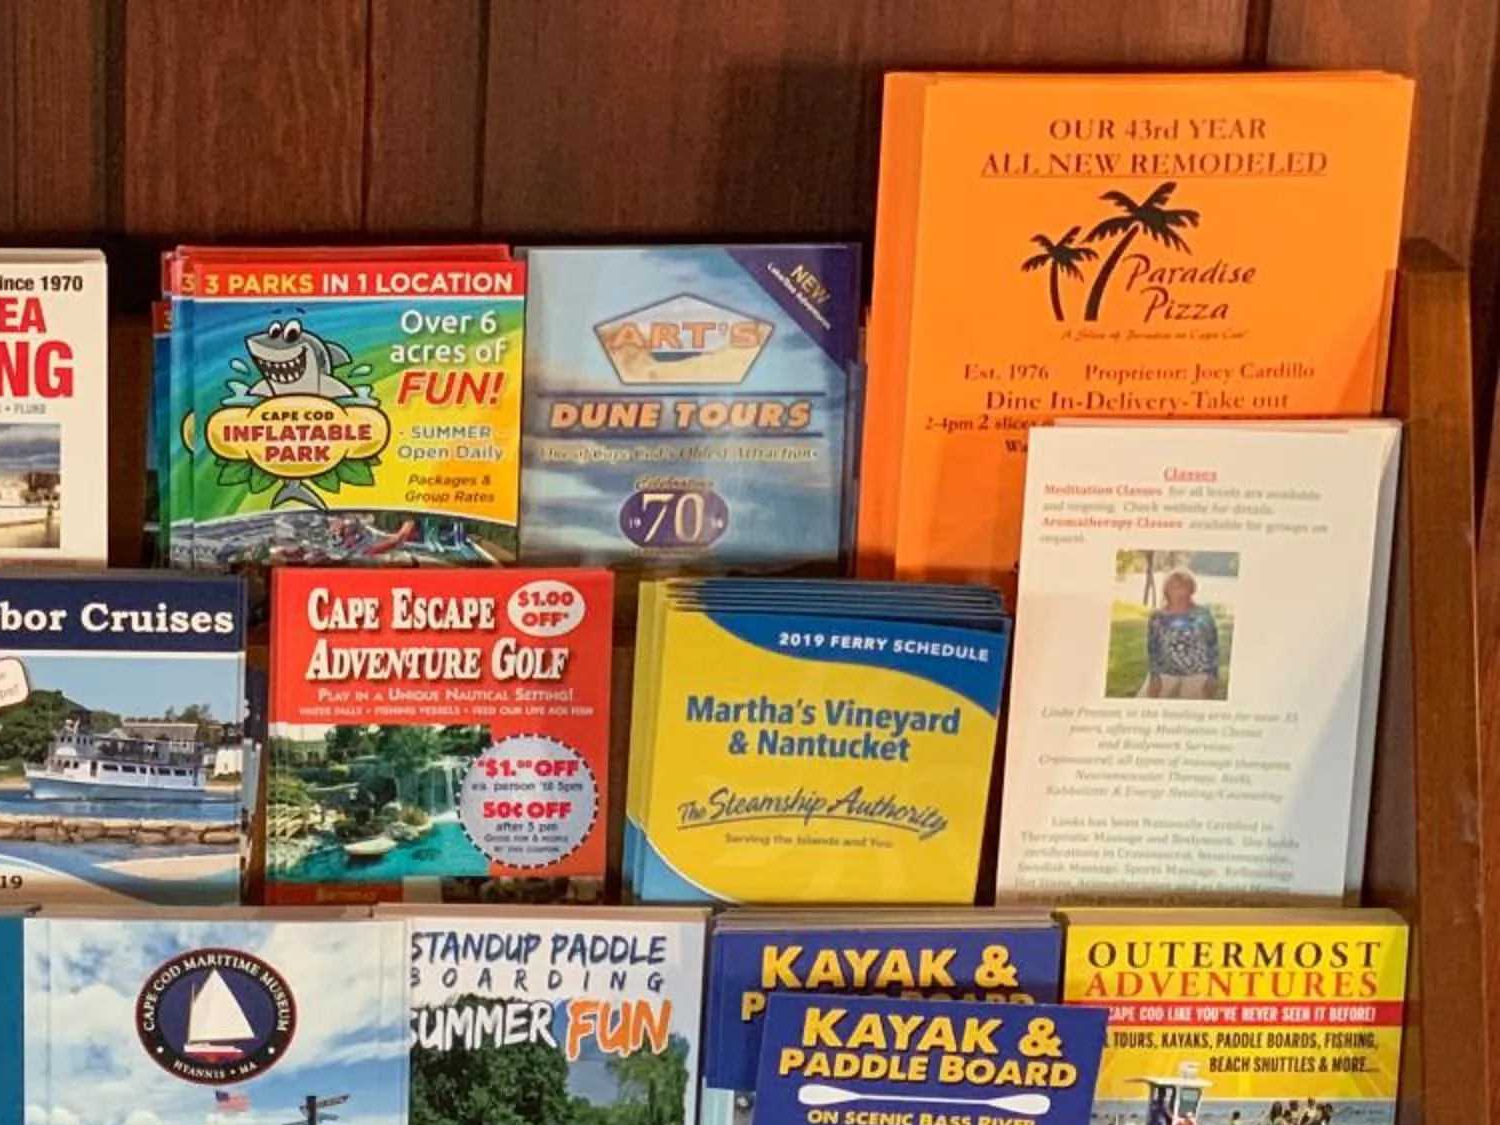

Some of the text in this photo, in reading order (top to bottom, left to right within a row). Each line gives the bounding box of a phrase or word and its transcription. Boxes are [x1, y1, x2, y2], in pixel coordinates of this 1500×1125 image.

[1049, 119, 1266, 140] OUR 43rd YEAR
[981, 152, 1327, 175] ALL NEW REMODELED
[40, 275, 83, 292] 1970
[205, 272, 513, 294] 3 PARKS IN 1 LOCATION
[1122, 254, 1255, 291] Paradise
[1140, 288, 1229, 324] Pizza
[400, 310, 496, 335] Over 6
[613, 322, 764, 349] ART'S
[390, 339, 508, 364] acres of
[398, 372, 505, 405] FUN!
[260, 410, 334, 422] CAPE COD
[550, 402, 811, 428] DUNE TOURS
[223, 423, 372, 443] INFLATABLE
[264, 446, 330, 463] PARK
[80, 603, 234, 633] Cruises
[307, 589, 495, 631] CAPE ESCAPE
[306, 639, 569, 680] ADVENTURE GOLF
[779, 633, 989, 661] 2019 FERRY SCHEDULE
[686, 696, 960, 735] Martha's Vineyard
[728, 731, 910, 762] & Nantucket
[411, 933, 667, 965] STANDUP PADDLE
[1088, 942, 1382, 968] OUTERMOST
[1084, 972, 1377, 998] ADVENTURES
[566, 999, 672, 1059] FUN
[803, 1008, 1062, 1058] KAYAK &
[779, 1049, 1076, 1088] PADDLE BOARD
[807, 1110, 837, 1125] ON
